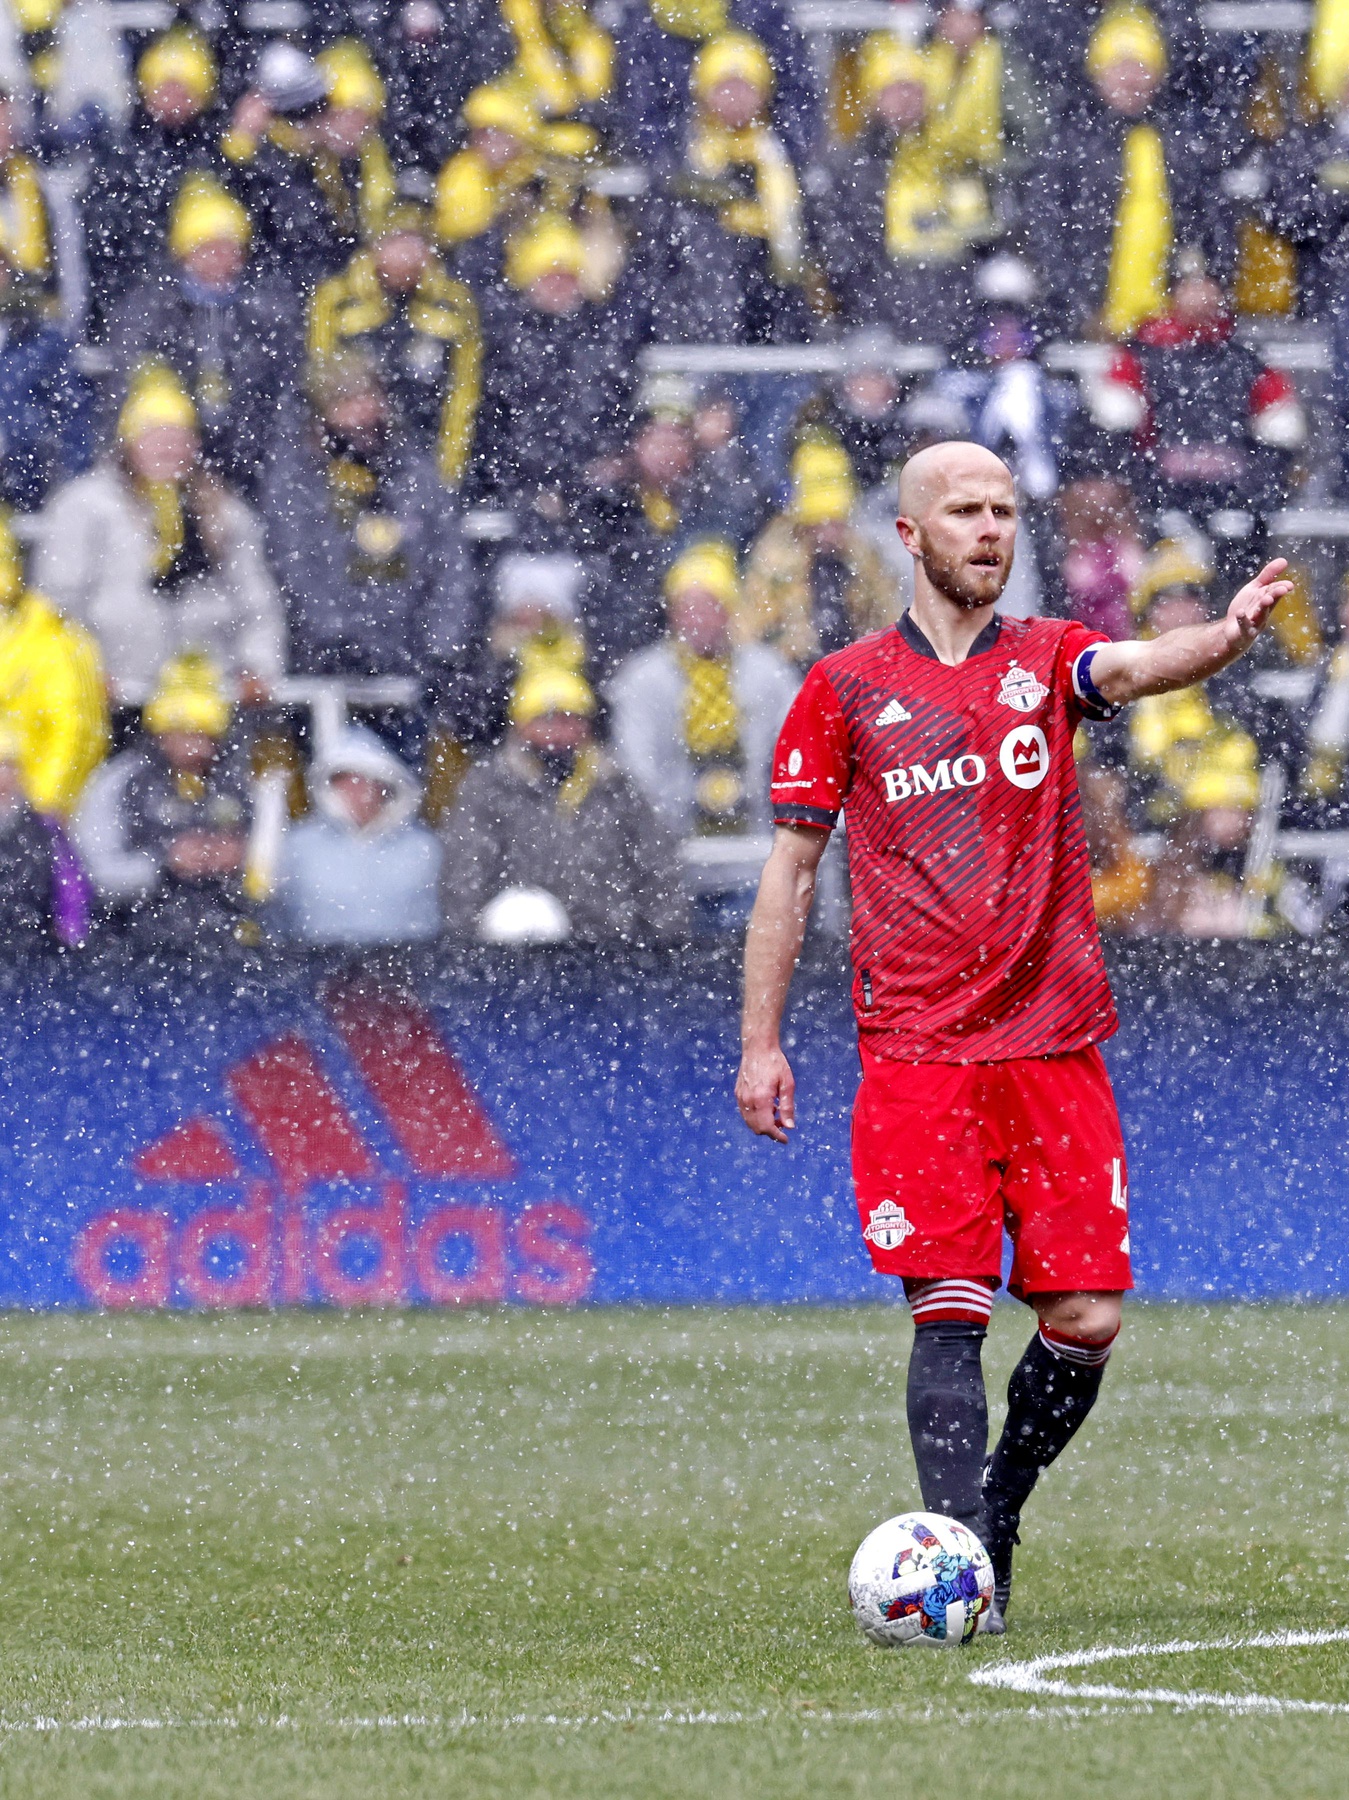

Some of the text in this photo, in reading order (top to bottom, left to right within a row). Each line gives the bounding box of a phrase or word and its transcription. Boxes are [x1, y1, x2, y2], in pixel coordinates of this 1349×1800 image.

[1003, 685, 1040, 699] TORONTO
[875, 710, 912, 726] adidas
[881, 754, 986, 803] BMO
[870, 1222, 906, 1232] TORONTO
[71, 1178, 597, 1307] adidas
